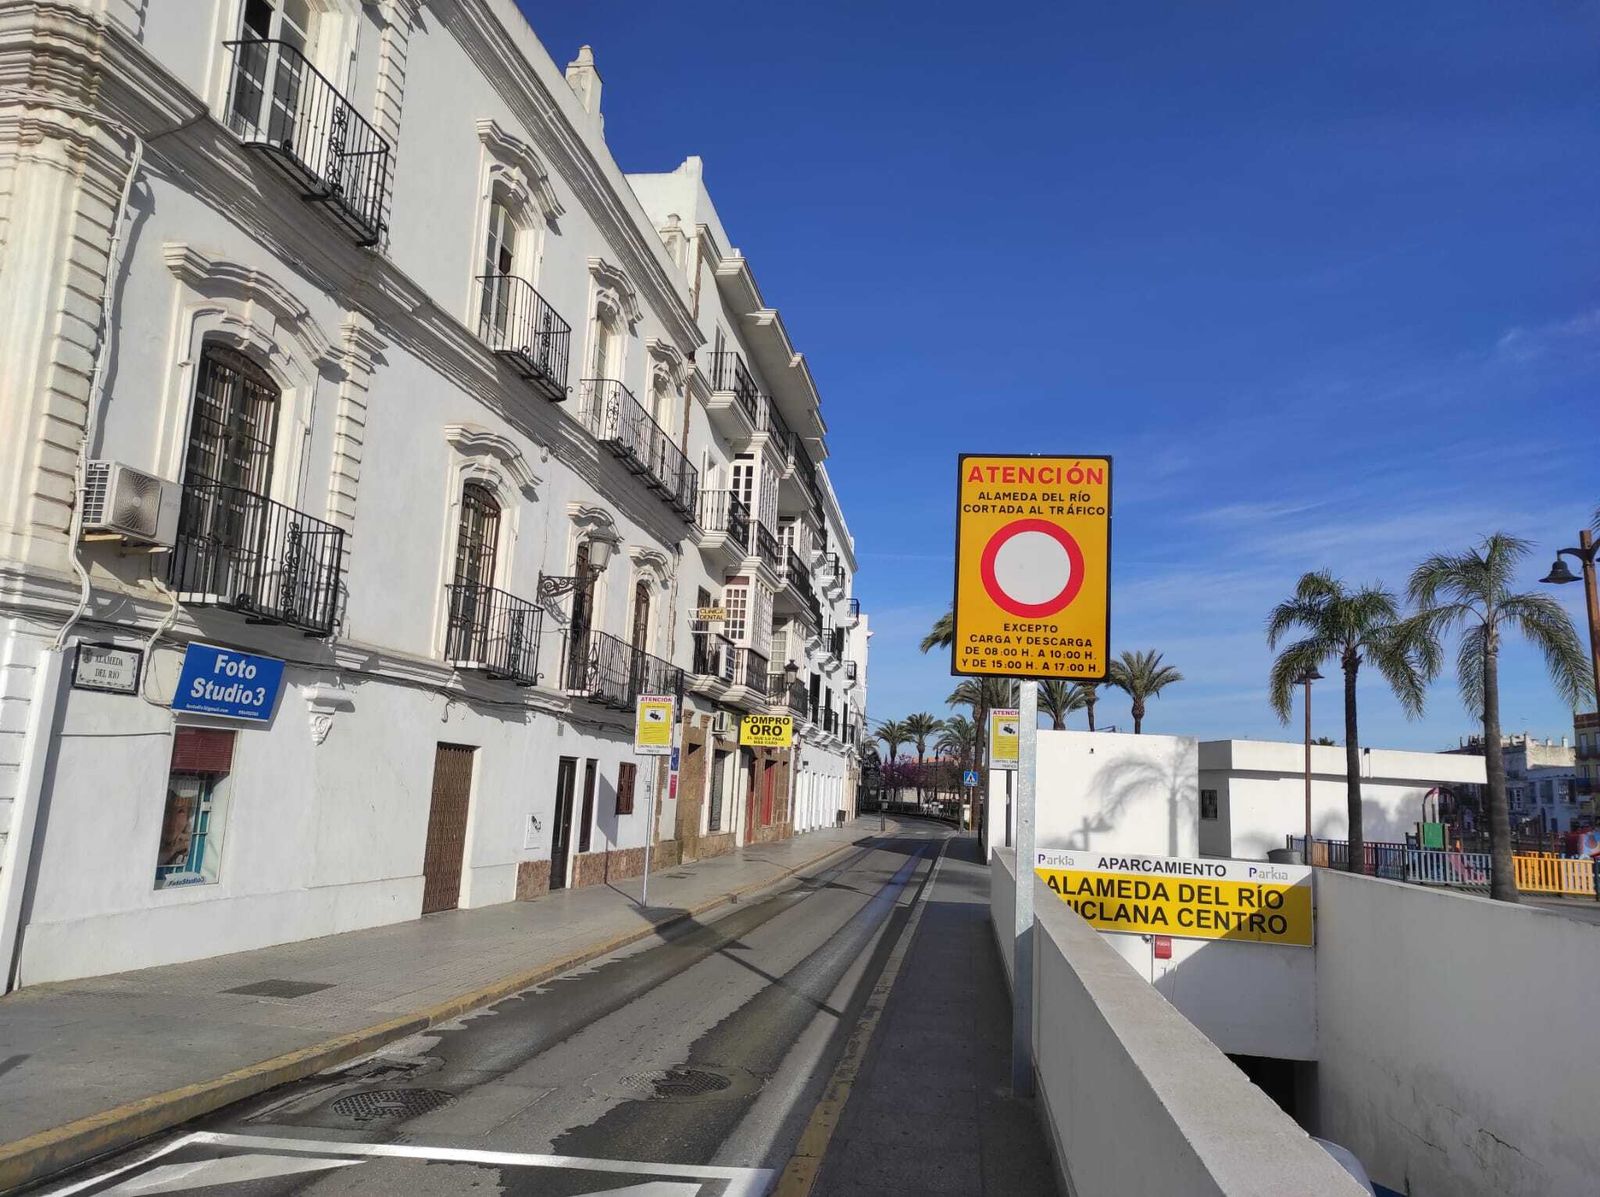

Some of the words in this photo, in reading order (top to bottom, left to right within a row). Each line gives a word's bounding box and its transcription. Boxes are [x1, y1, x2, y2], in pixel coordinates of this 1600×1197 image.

[968, 461, 1103, 485] ATENCIÓN
[978, 491, 1037, 502] ALAMEDA
[1042, 493, 1064, 502] DEL
[1069, 491, 1091, 503] RÍO
[963, 504, 1024, 514] CORTADA
[1029, 505, 1044, 515] AL
[1049, 503, 1105, 516] TRÁFICO
[1003, 623, 1058, 633] EXCEPTO
[970, 634, 1011, 644] CARGA
[1016, 636, 1022, 644] Y
[1026, 636, 1092, 647] DESCARGA
[965, 646, 980, 655] DE
[1038, 649, 1046, 658] A
[214, 654, 257, 680] Foto
[961, 658, 968, 667] Y
[972, 658, 987, 668] DE
[1042, 662, 1050, 671] A
[95, 668, 107, 678] DEL
[743, 715, 790, 725] COMPRO
[750, 725, 783, 736] ORO
[1038, 853, 1075, 866] Parkia
[1097, 857, 1227, 878] APARCAMIENTO
[1249, 866, 1289, 881] Parkia
[1047, 875, 1170, 902] ALAMEDA
[1178, 883, 1229, 906] DEL
[1238, 884, 1284, 910] RÍO
[1177, 907, 1288, 935] CENTRO
